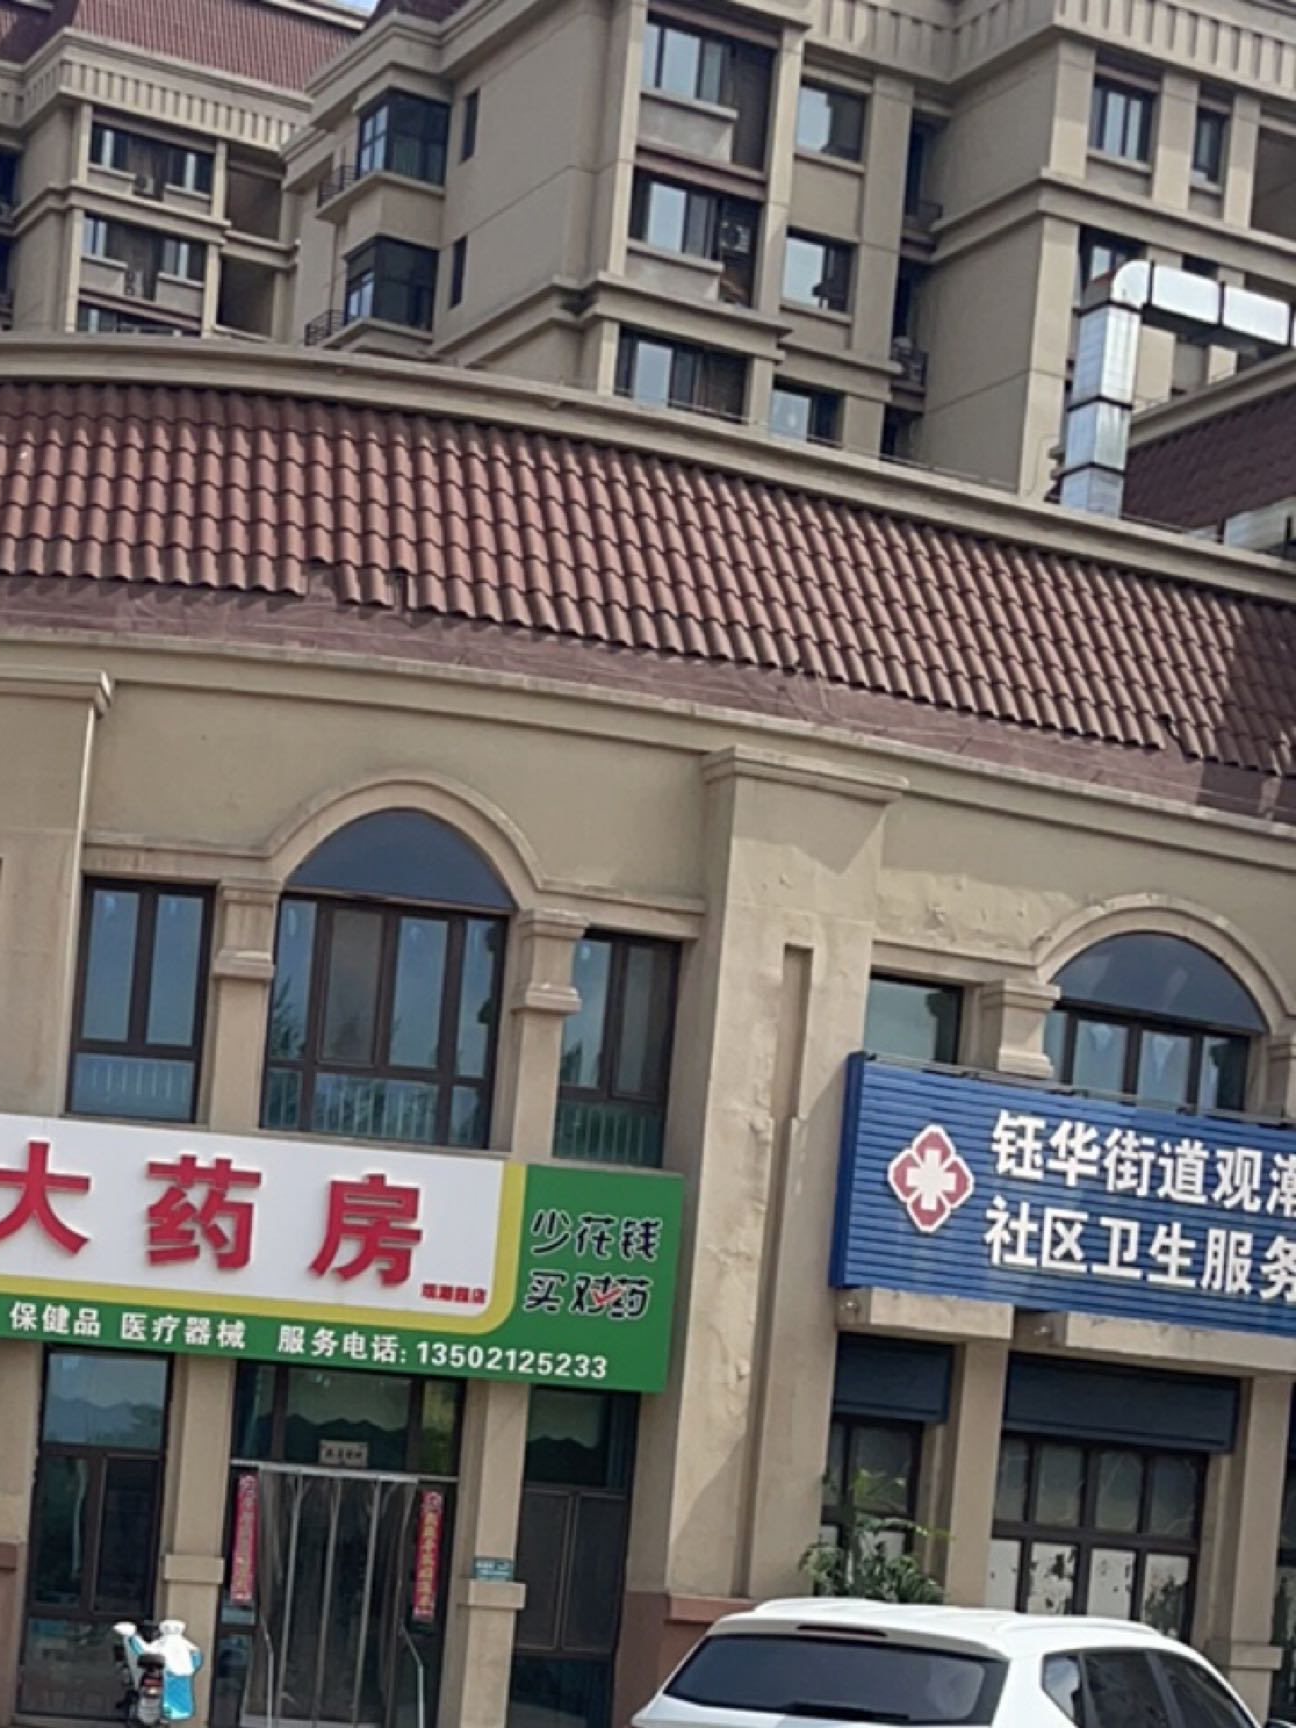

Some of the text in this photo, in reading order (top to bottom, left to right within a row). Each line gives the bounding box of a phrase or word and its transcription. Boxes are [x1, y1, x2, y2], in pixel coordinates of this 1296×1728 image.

[532, 1210, 662, 1262] 少花钱
[524, 1269, 652, 1321] 买对药
[9, 1301, 102, 1338] 保健品
[121, 1310, 246, 1349] 医疗器械
[278, 1324, 406, 1364] 服务电话:
[416, 1340, 608, 1380] 13502125233
